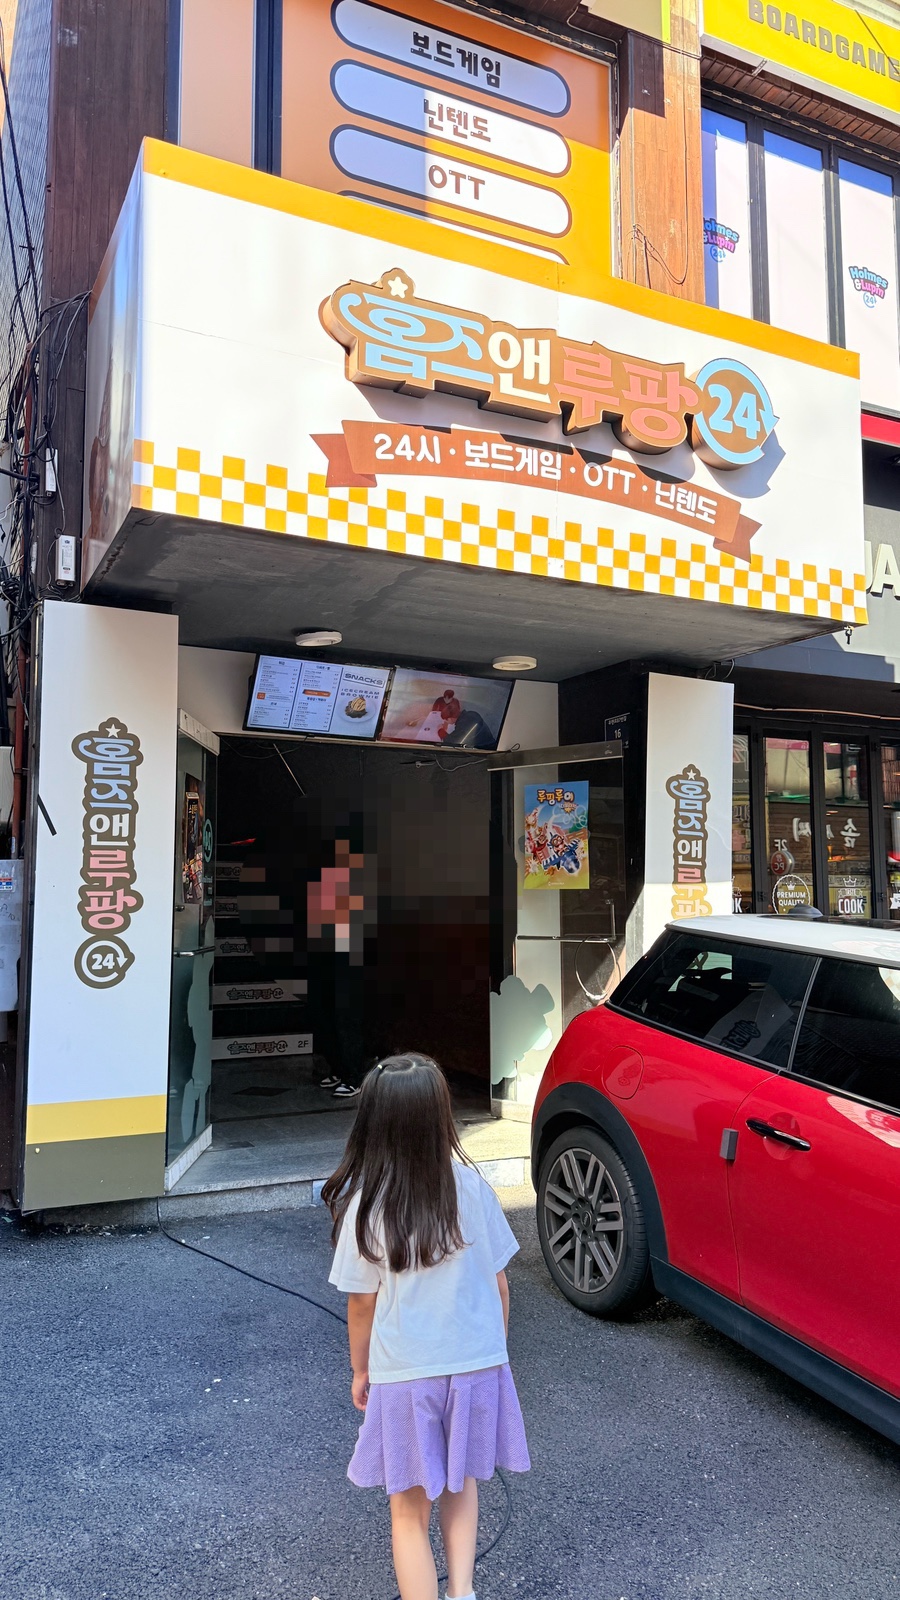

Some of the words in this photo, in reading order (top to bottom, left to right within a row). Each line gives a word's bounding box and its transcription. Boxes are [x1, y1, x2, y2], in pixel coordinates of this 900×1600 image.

[410, 31, 502, 88] 보드게임
[424, 98, 492, 143] 닌텐도
[428, 164, 486, 201] OTT
[849, 266, 888, 289] Holmes
[708, 383, 763, 439] 24
[374, 432, 441, 464] 24시
[464, 439, 562, 480] 보드게임
[584, 461, 636, 495] OTT
[654, 482, 718, 525] 닌텐도
[344, 673, 383, 686] SNACKS
[614, 728, 622, 739] 16
[538, 788, 575, 806] 루핑루이
[838, 898, 864, 914] COOK
[91, 953, 115, 970] 24
[297, 1040, 309, 1049] 2F
